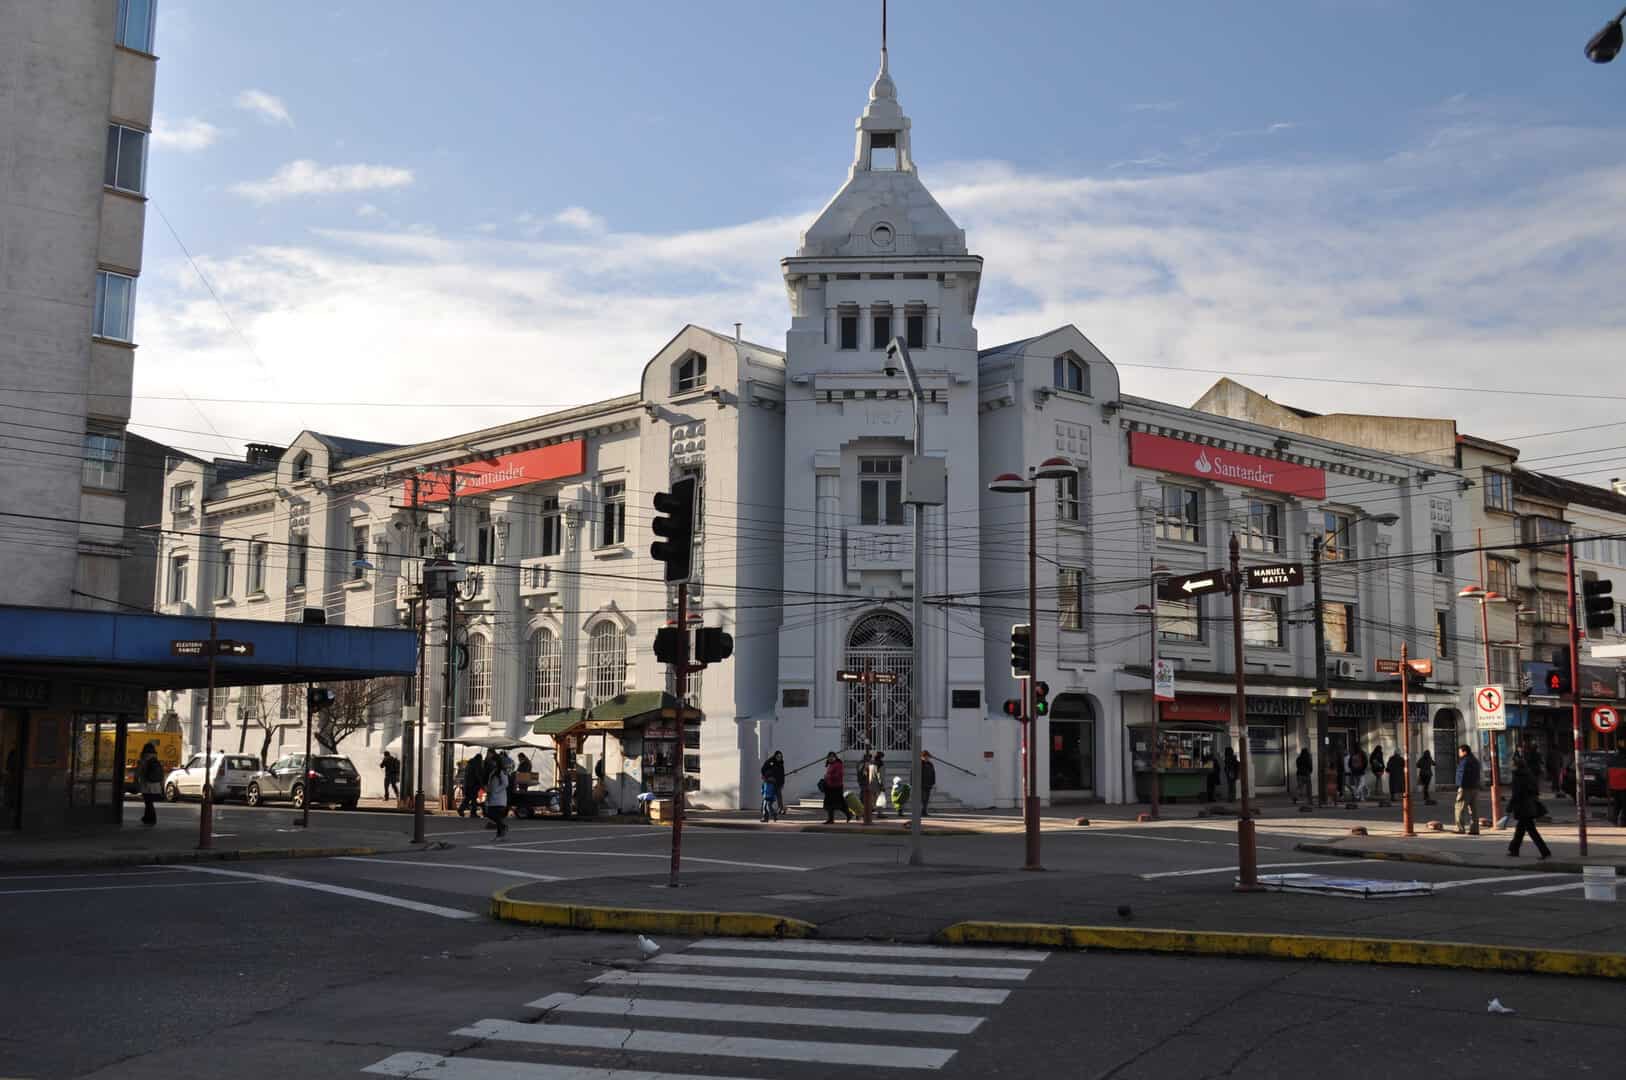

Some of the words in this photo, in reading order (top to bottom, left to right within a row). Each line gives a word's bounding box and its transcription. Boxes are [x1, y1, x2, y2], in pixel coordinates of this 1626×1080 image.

[1214, 456, 1274, 485] Santander
[1254, 567, 1286, 577] MANUEL
[1262, 575, 1289, 584] MATTA
